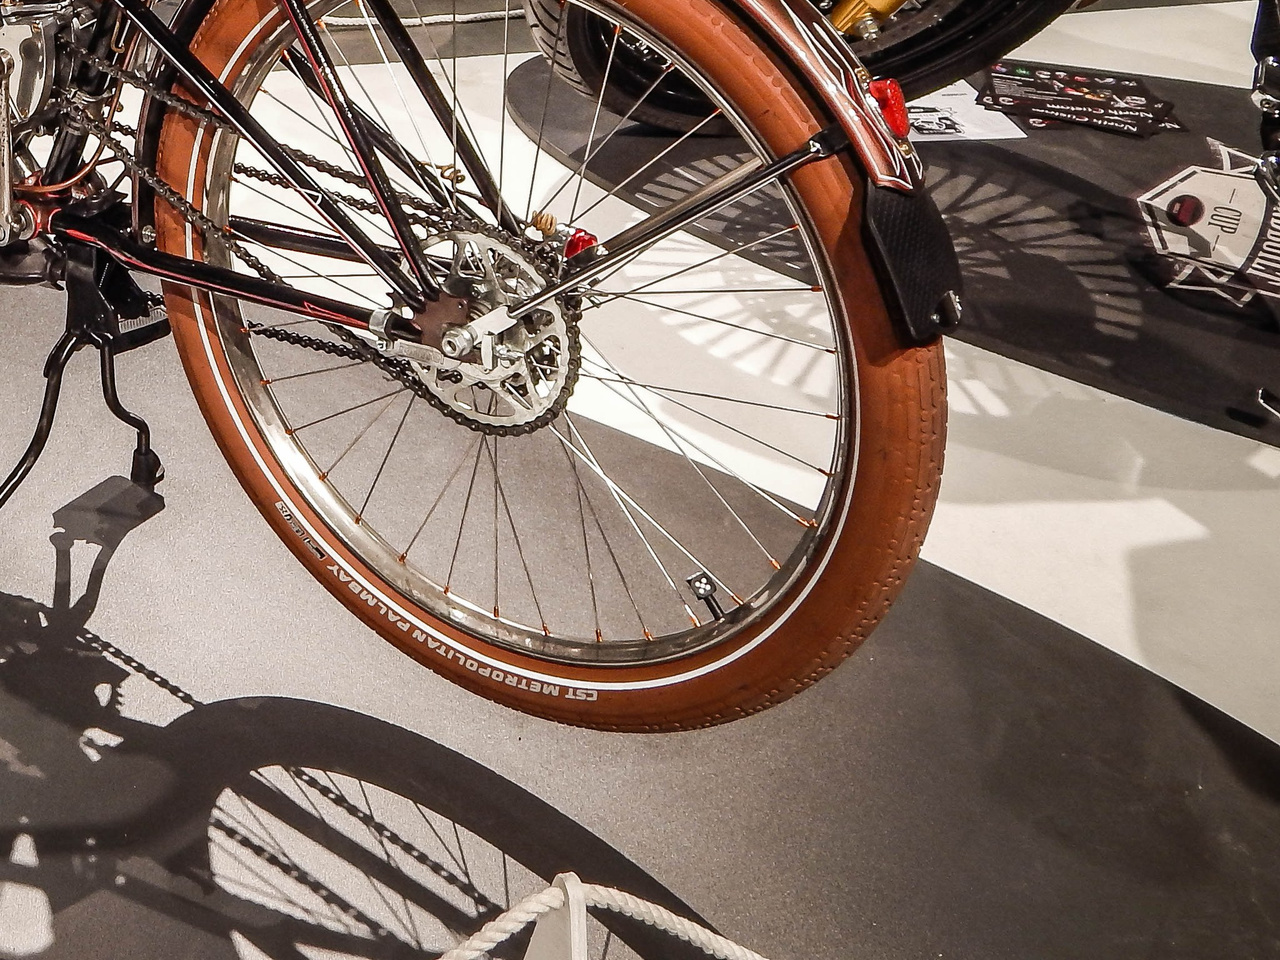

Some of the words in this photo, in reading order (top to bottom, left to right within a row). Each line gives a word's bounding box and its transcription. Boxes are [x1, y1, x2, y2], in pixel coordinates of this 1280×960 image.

[1208, 206, 1242, 234] CUP
[326, 563, 411, 632] PALMBAY
[411, 629, 560, 696] METROPOLITAN
[565, 687, 598, 702] CST
